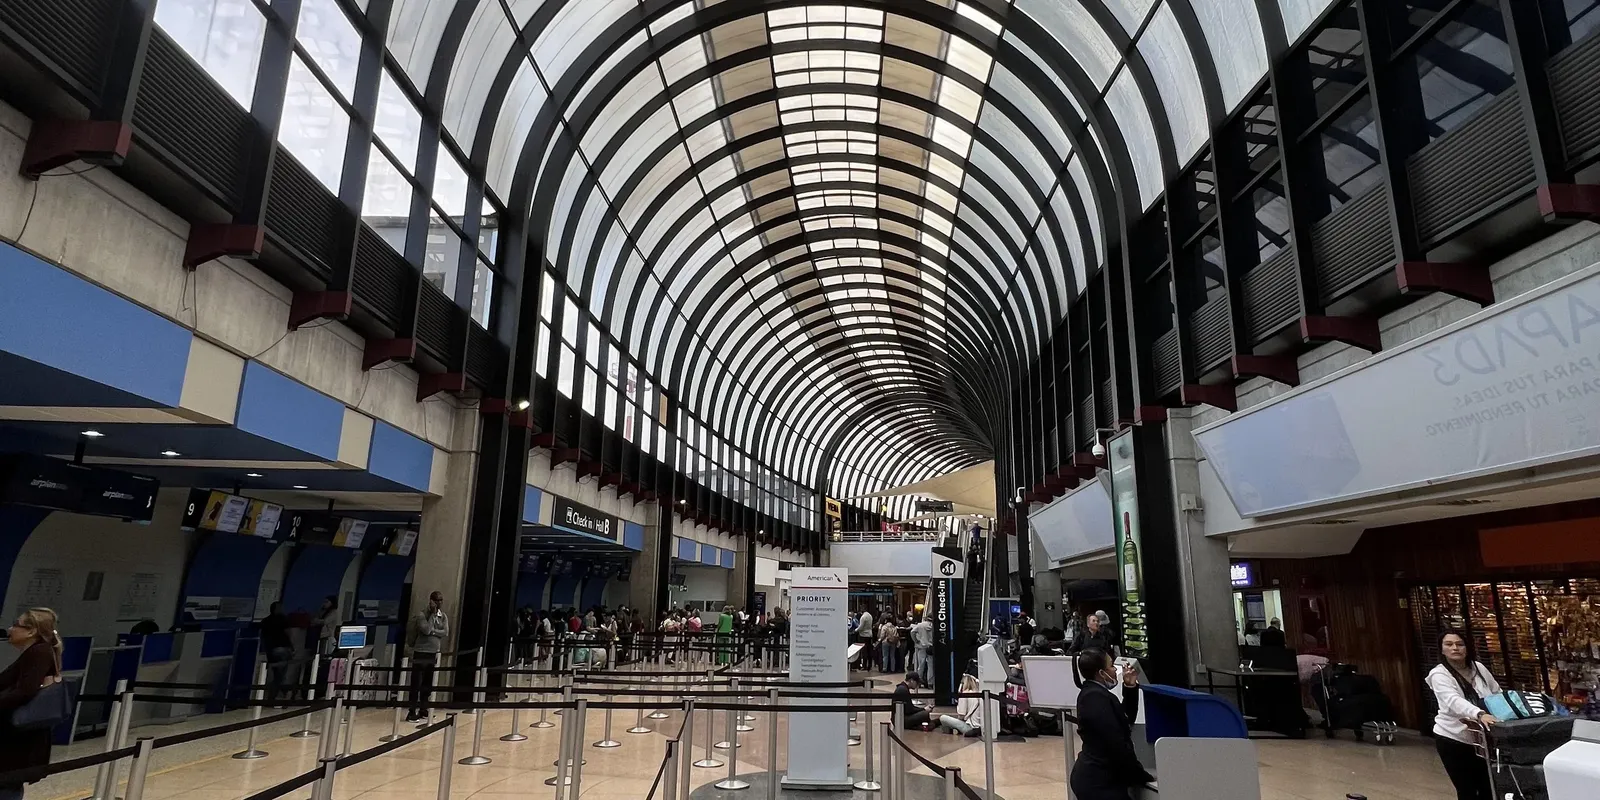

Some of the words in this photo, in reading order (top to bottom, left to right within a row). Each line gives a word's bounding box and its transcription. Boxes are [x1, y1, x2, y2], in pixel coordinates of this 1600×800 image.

[188, 503, 195, 516] 9
[292, 516, 302, 527] 10
[573, 512, 588, 528] Check
[588, 517, 593, 529] in
[604, 518, 610, 535] B
[289, 526, 297, 538] A
[807, 574, 834, 582] American
[937, 580, 946, 621] Check-in
[939, 623, 947, 645] Auto
